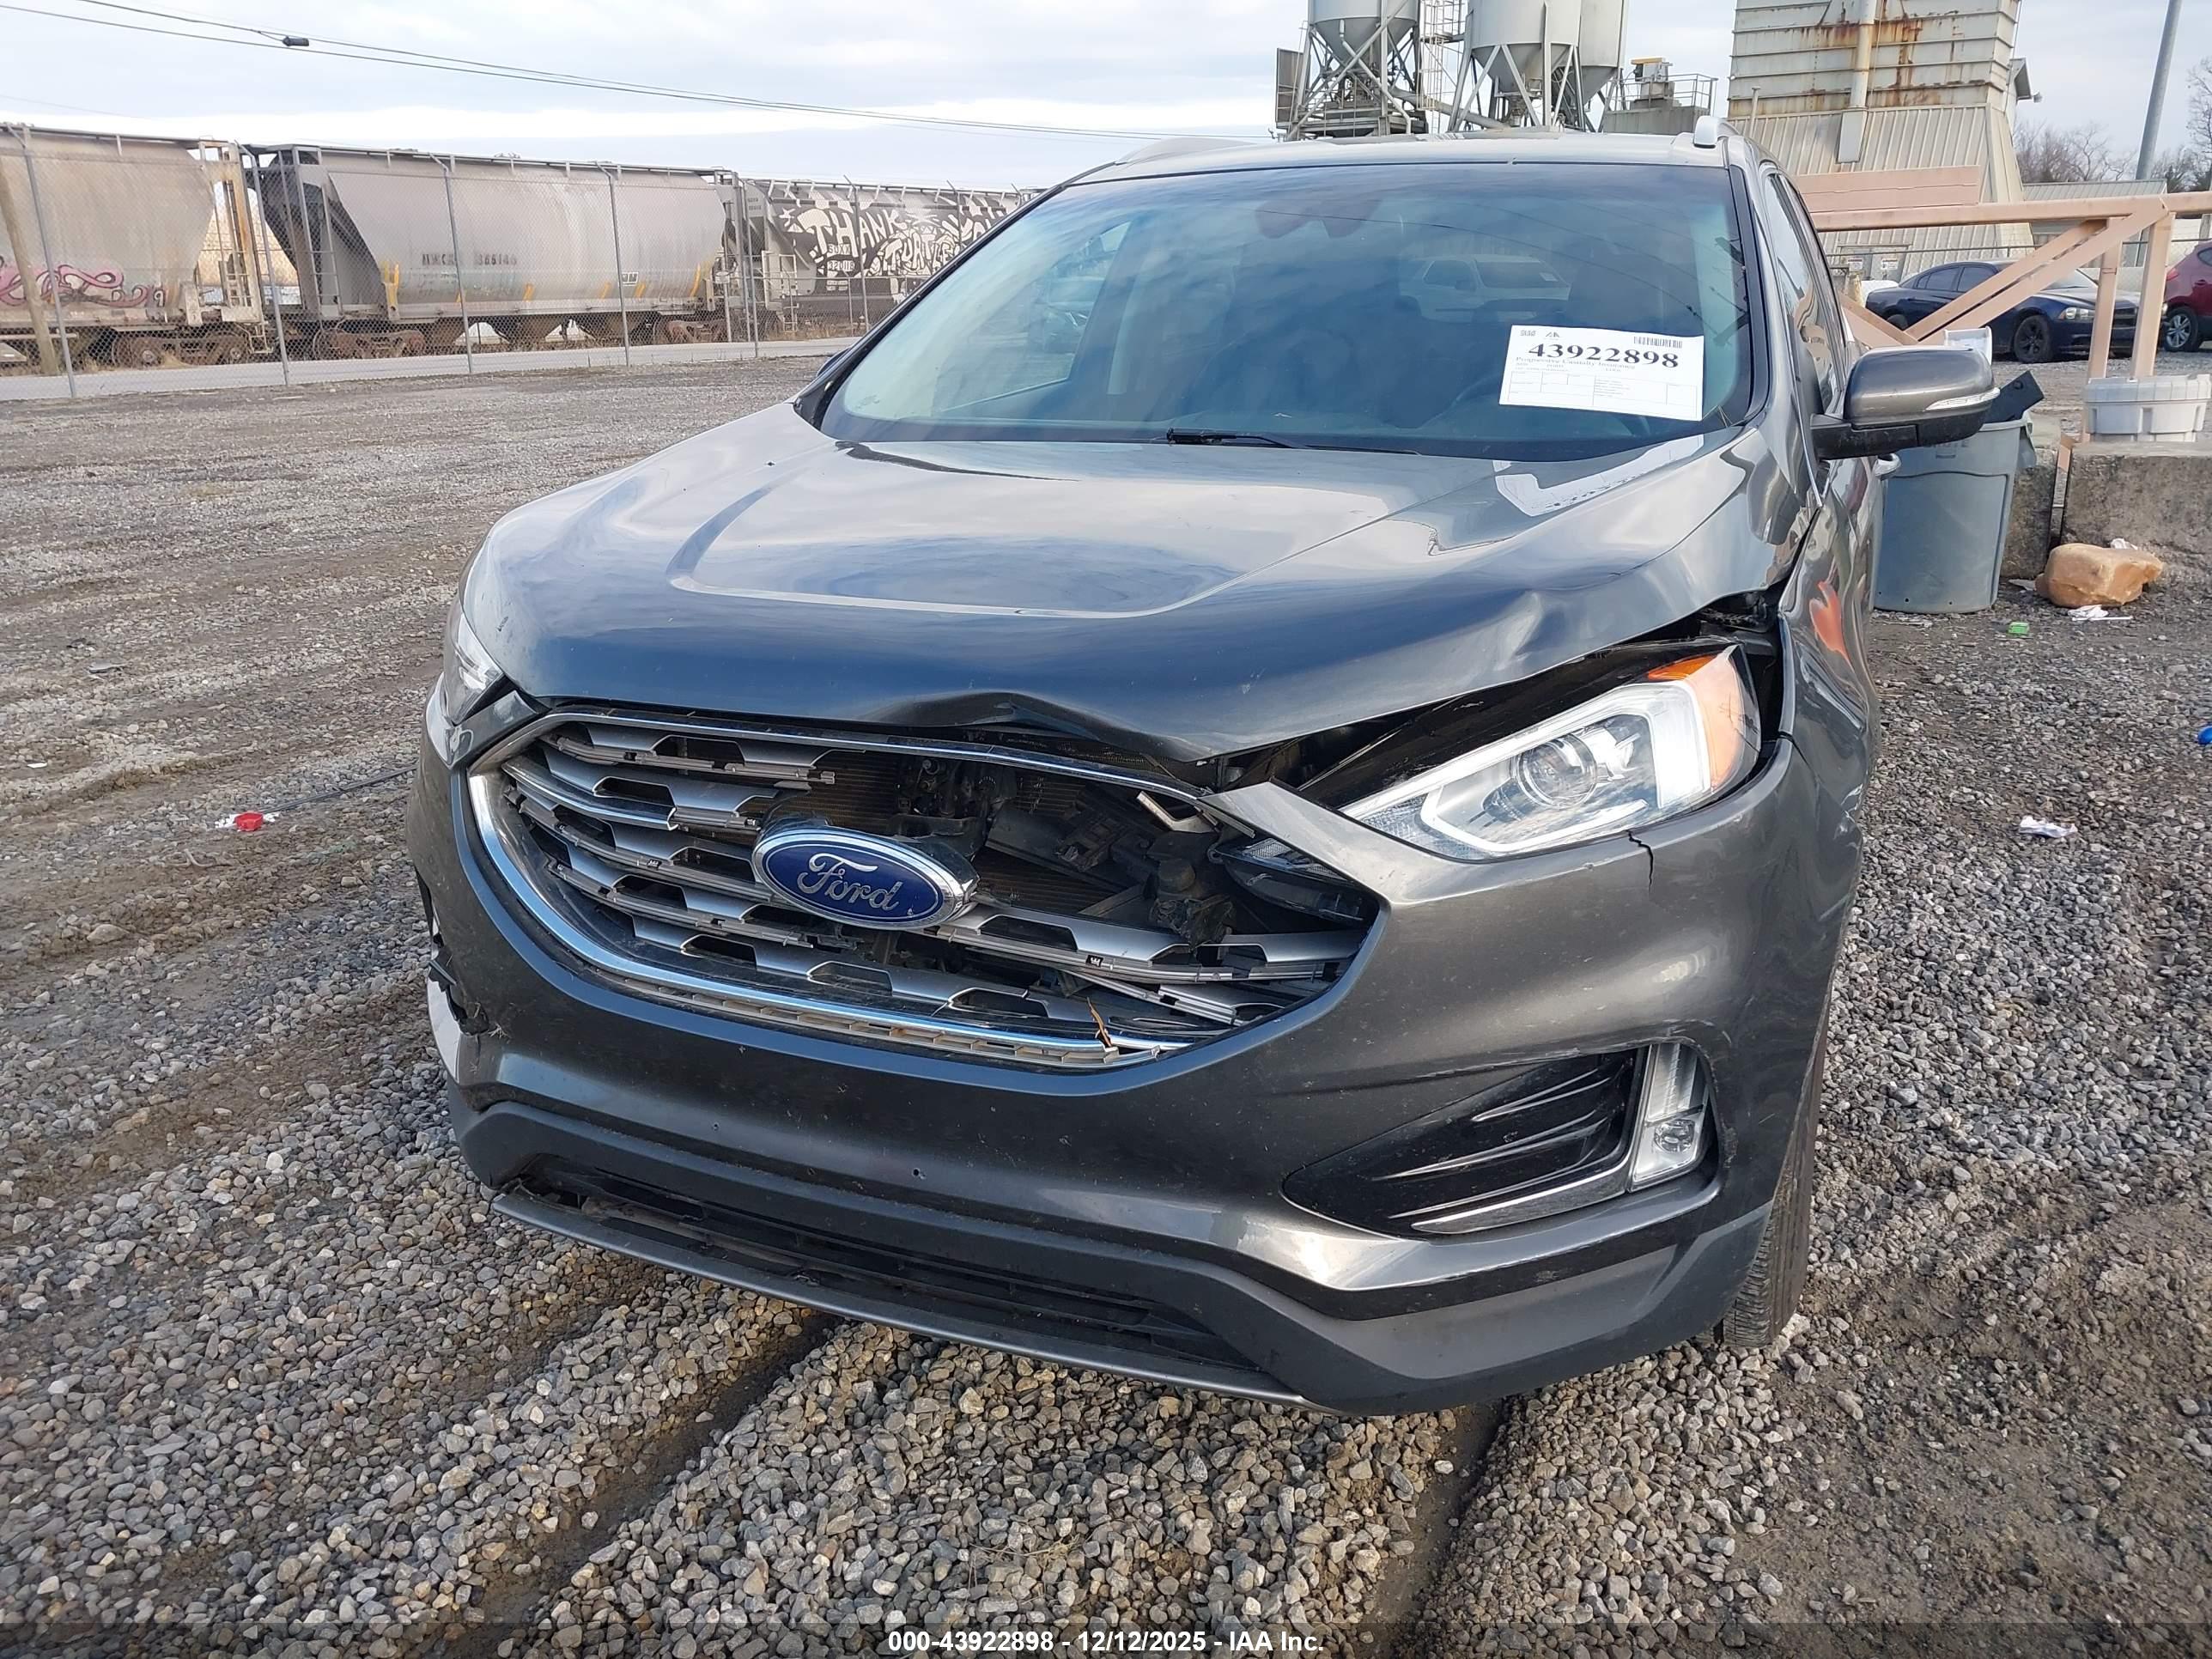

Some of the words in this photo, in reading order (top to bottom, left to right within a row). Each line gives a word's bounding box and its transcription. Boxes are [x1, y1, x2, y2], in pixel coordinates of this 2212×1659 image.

[797, 209, 908, 257] THANK
[942, 214, 992, 241] YO
[1528, 343, 1679, 368] 43922898
[797, 853, 902, 910] Ford
